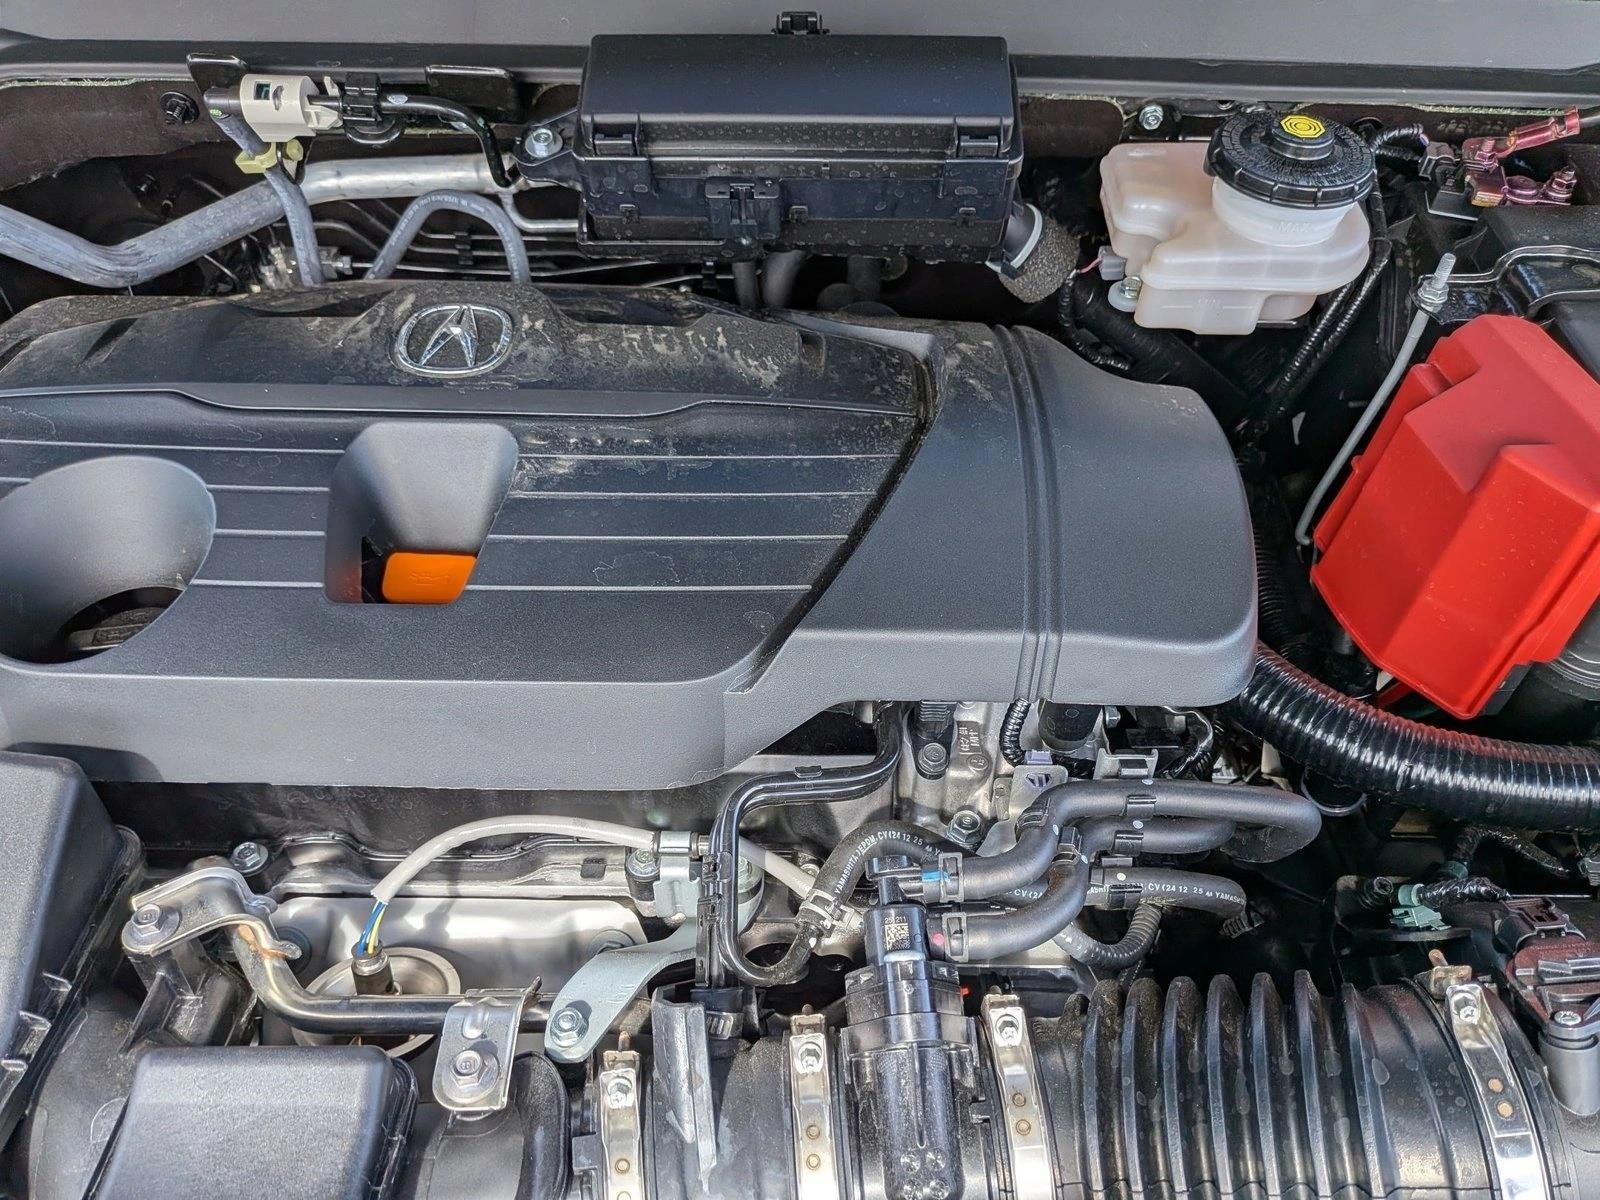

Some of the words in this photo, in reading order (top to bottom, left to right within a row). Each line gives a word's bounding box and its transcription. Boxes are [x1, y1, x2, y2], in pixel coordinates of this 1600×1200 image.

[834, 854, 859, 894] YAMASHITA
[902, 833, 912, 843] 12
[913, 835, 924, 846] 25
[1179, 885, 1189, 895] 12
[1193, 886, 1204, 896] 25
